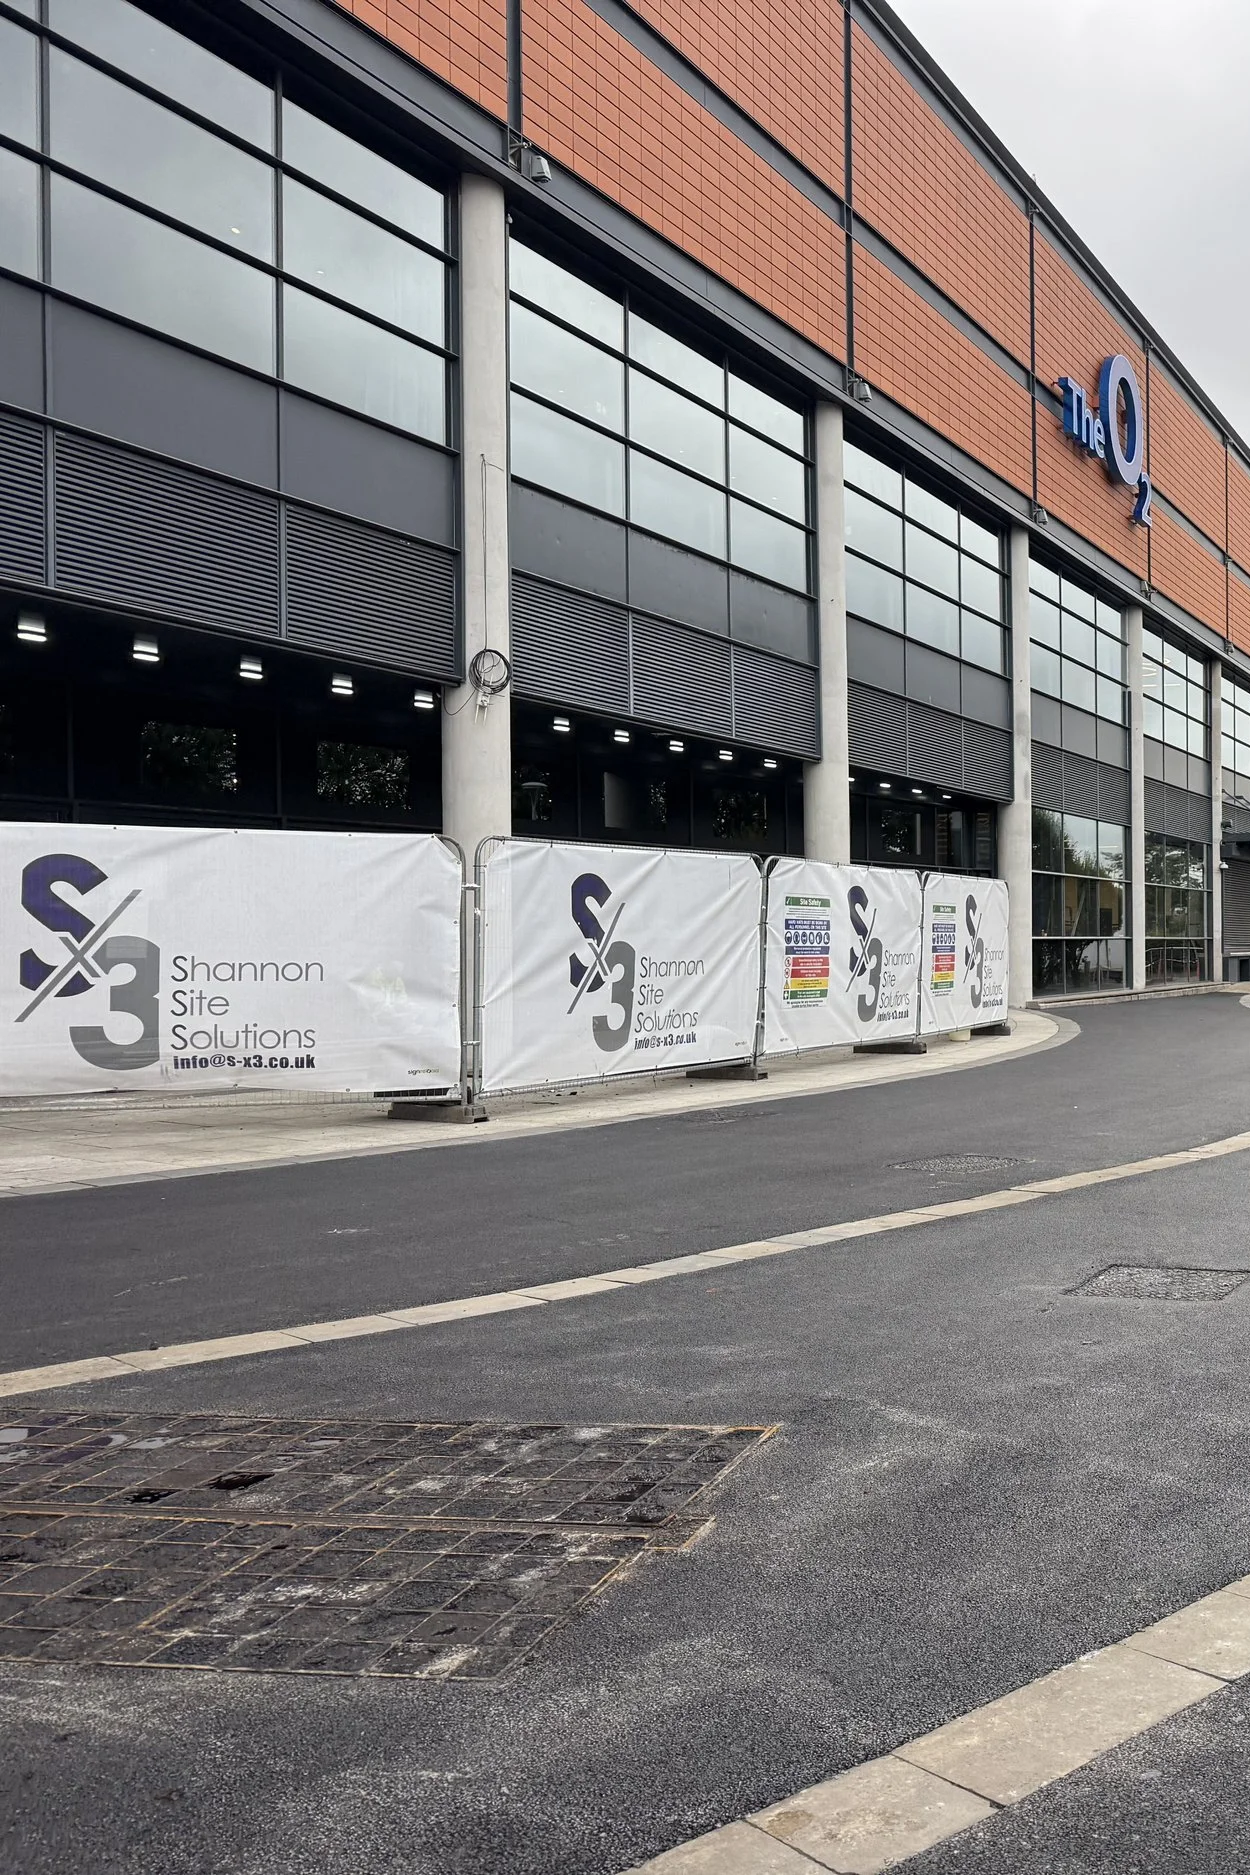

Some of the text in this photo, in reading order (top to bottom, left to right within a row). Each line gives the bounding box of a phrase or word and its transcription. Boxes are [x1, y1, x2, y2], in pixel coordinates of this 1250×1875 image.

[1060, 377, 1106, 459] The
[170, 955, 324, 983] Shannon
[639, 956, 705, 978] Shannon
[883, 949, 916, 967] Shannon
[881, 971, 897, 988] Site
[170, 989, 230, 1017] Site
[637, 984, 664, 1006] Site
[878, 991, 911, 1009] Solutions
[634, 1009, 699, 1033] Solutions
[170, 1022, 316, 1051] Solutions
[634, 1031, 697, 1050] info@s-x3.co.uk
[173, 1054, 316, 1070] info@s-x3.co.uk
